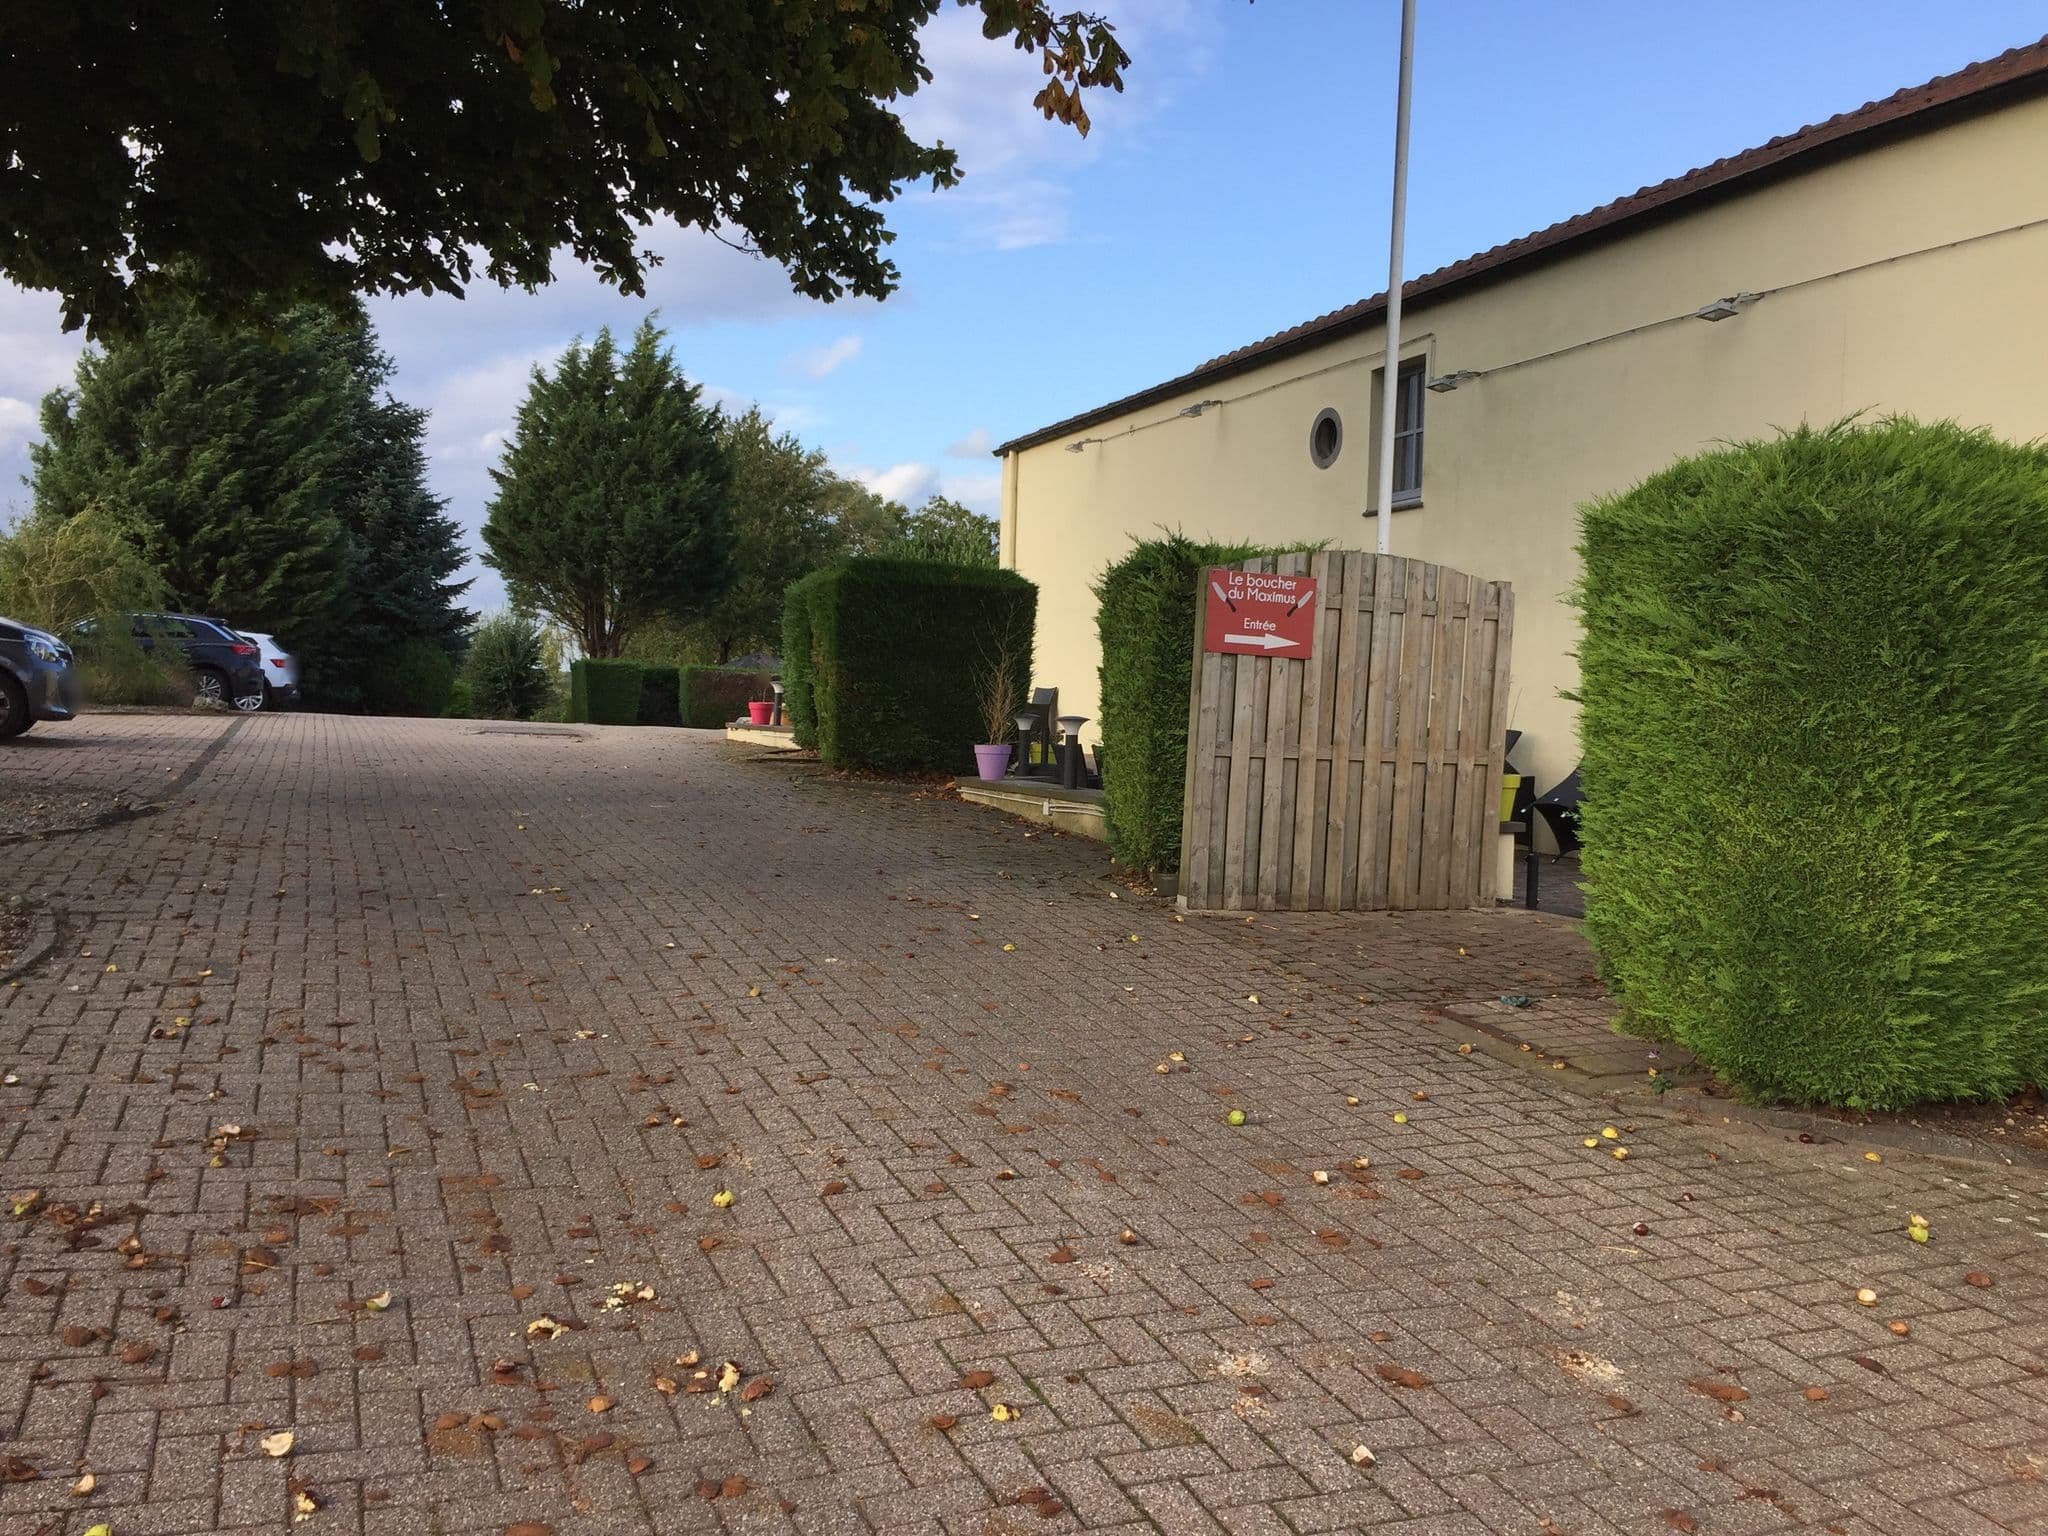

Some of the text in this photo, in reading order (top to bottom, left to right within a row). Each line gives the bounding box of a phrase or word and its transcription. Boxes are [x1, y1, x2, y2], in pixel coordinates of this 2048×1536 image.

[1228, 572, 1297, 589] Le boucher
[1228, 587, 1296, 604] du Maximus
[1243, 618, 1276, 631] Entrée
